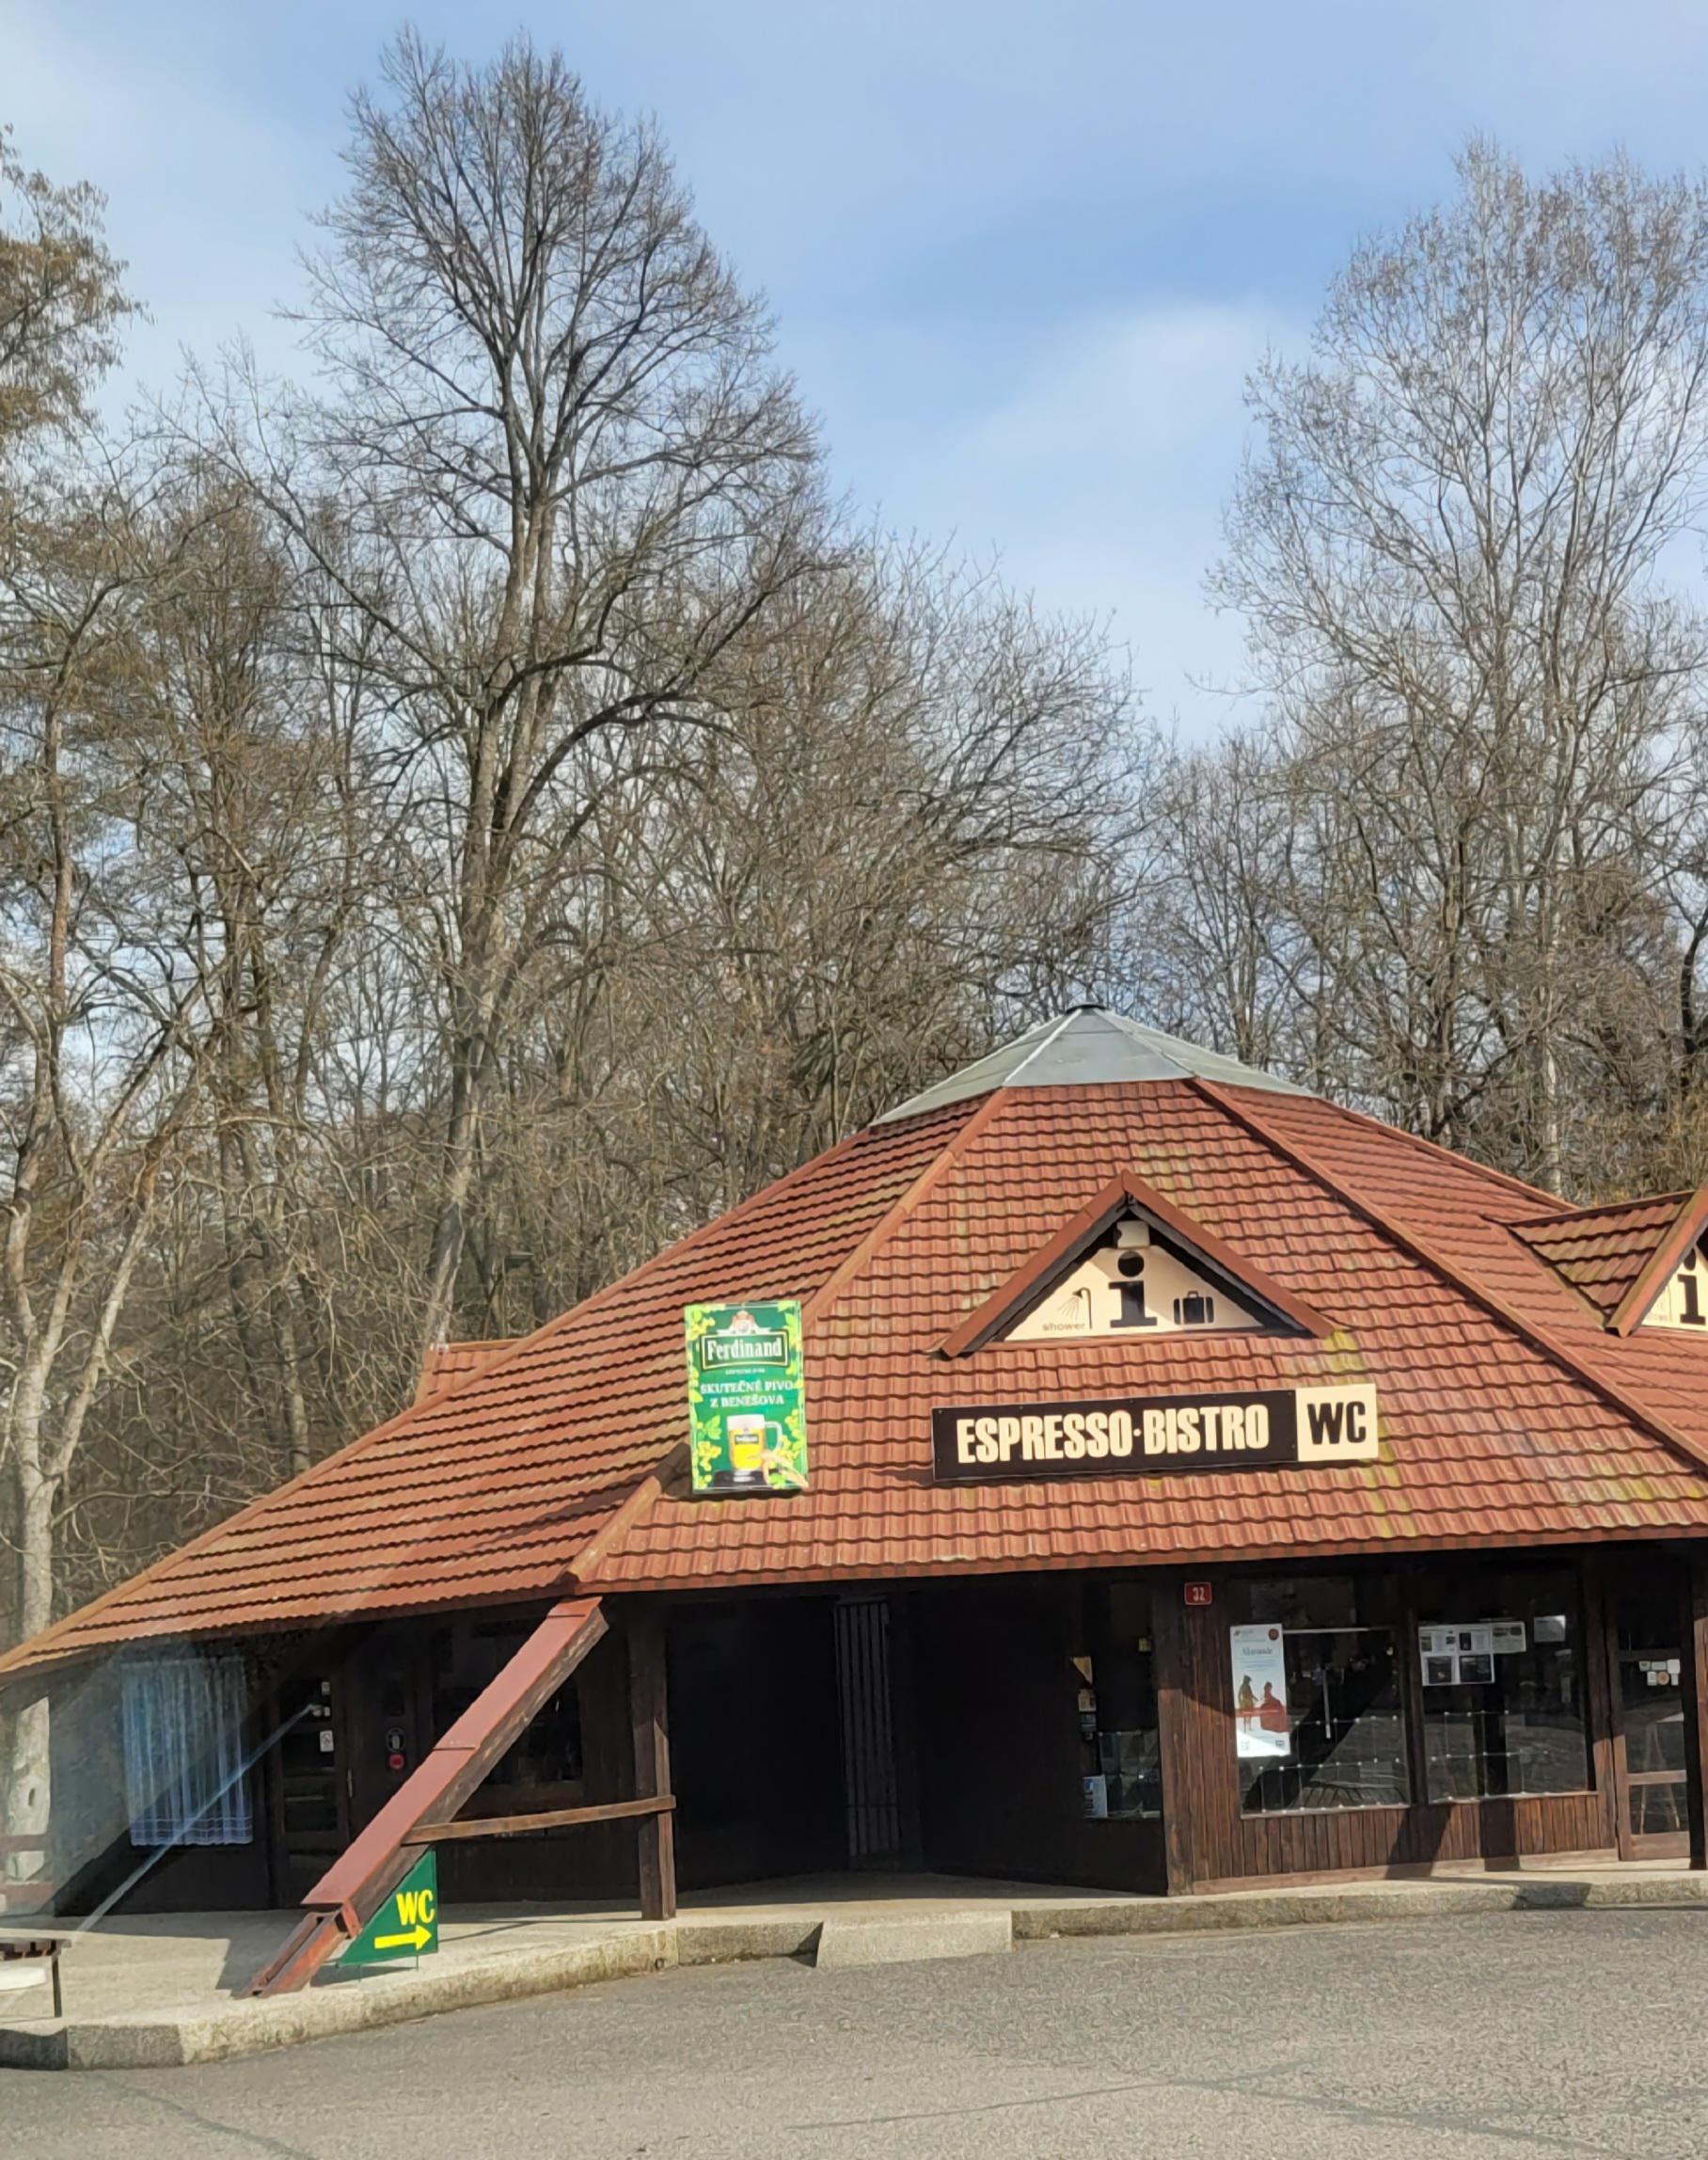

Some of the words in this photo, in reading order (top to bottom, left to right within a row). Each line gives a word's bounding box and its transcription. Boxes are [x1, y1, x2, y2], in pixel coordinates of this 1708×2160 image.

[1042, 1322, 1084, 1331] shower
[707, 1337, 783, 1361] Ferdinand
[701, 1379, 762, 1394] SKUTEČNÉ
[765, 1380, 793, 1391] PIVO
[710, 1398, 719, 1407] Z
[721, 1394, 784, 1407] BENEŠOVA
[1306, 1401, 1367, 1446] WC
[396, 1889, 435, 1926] WC
